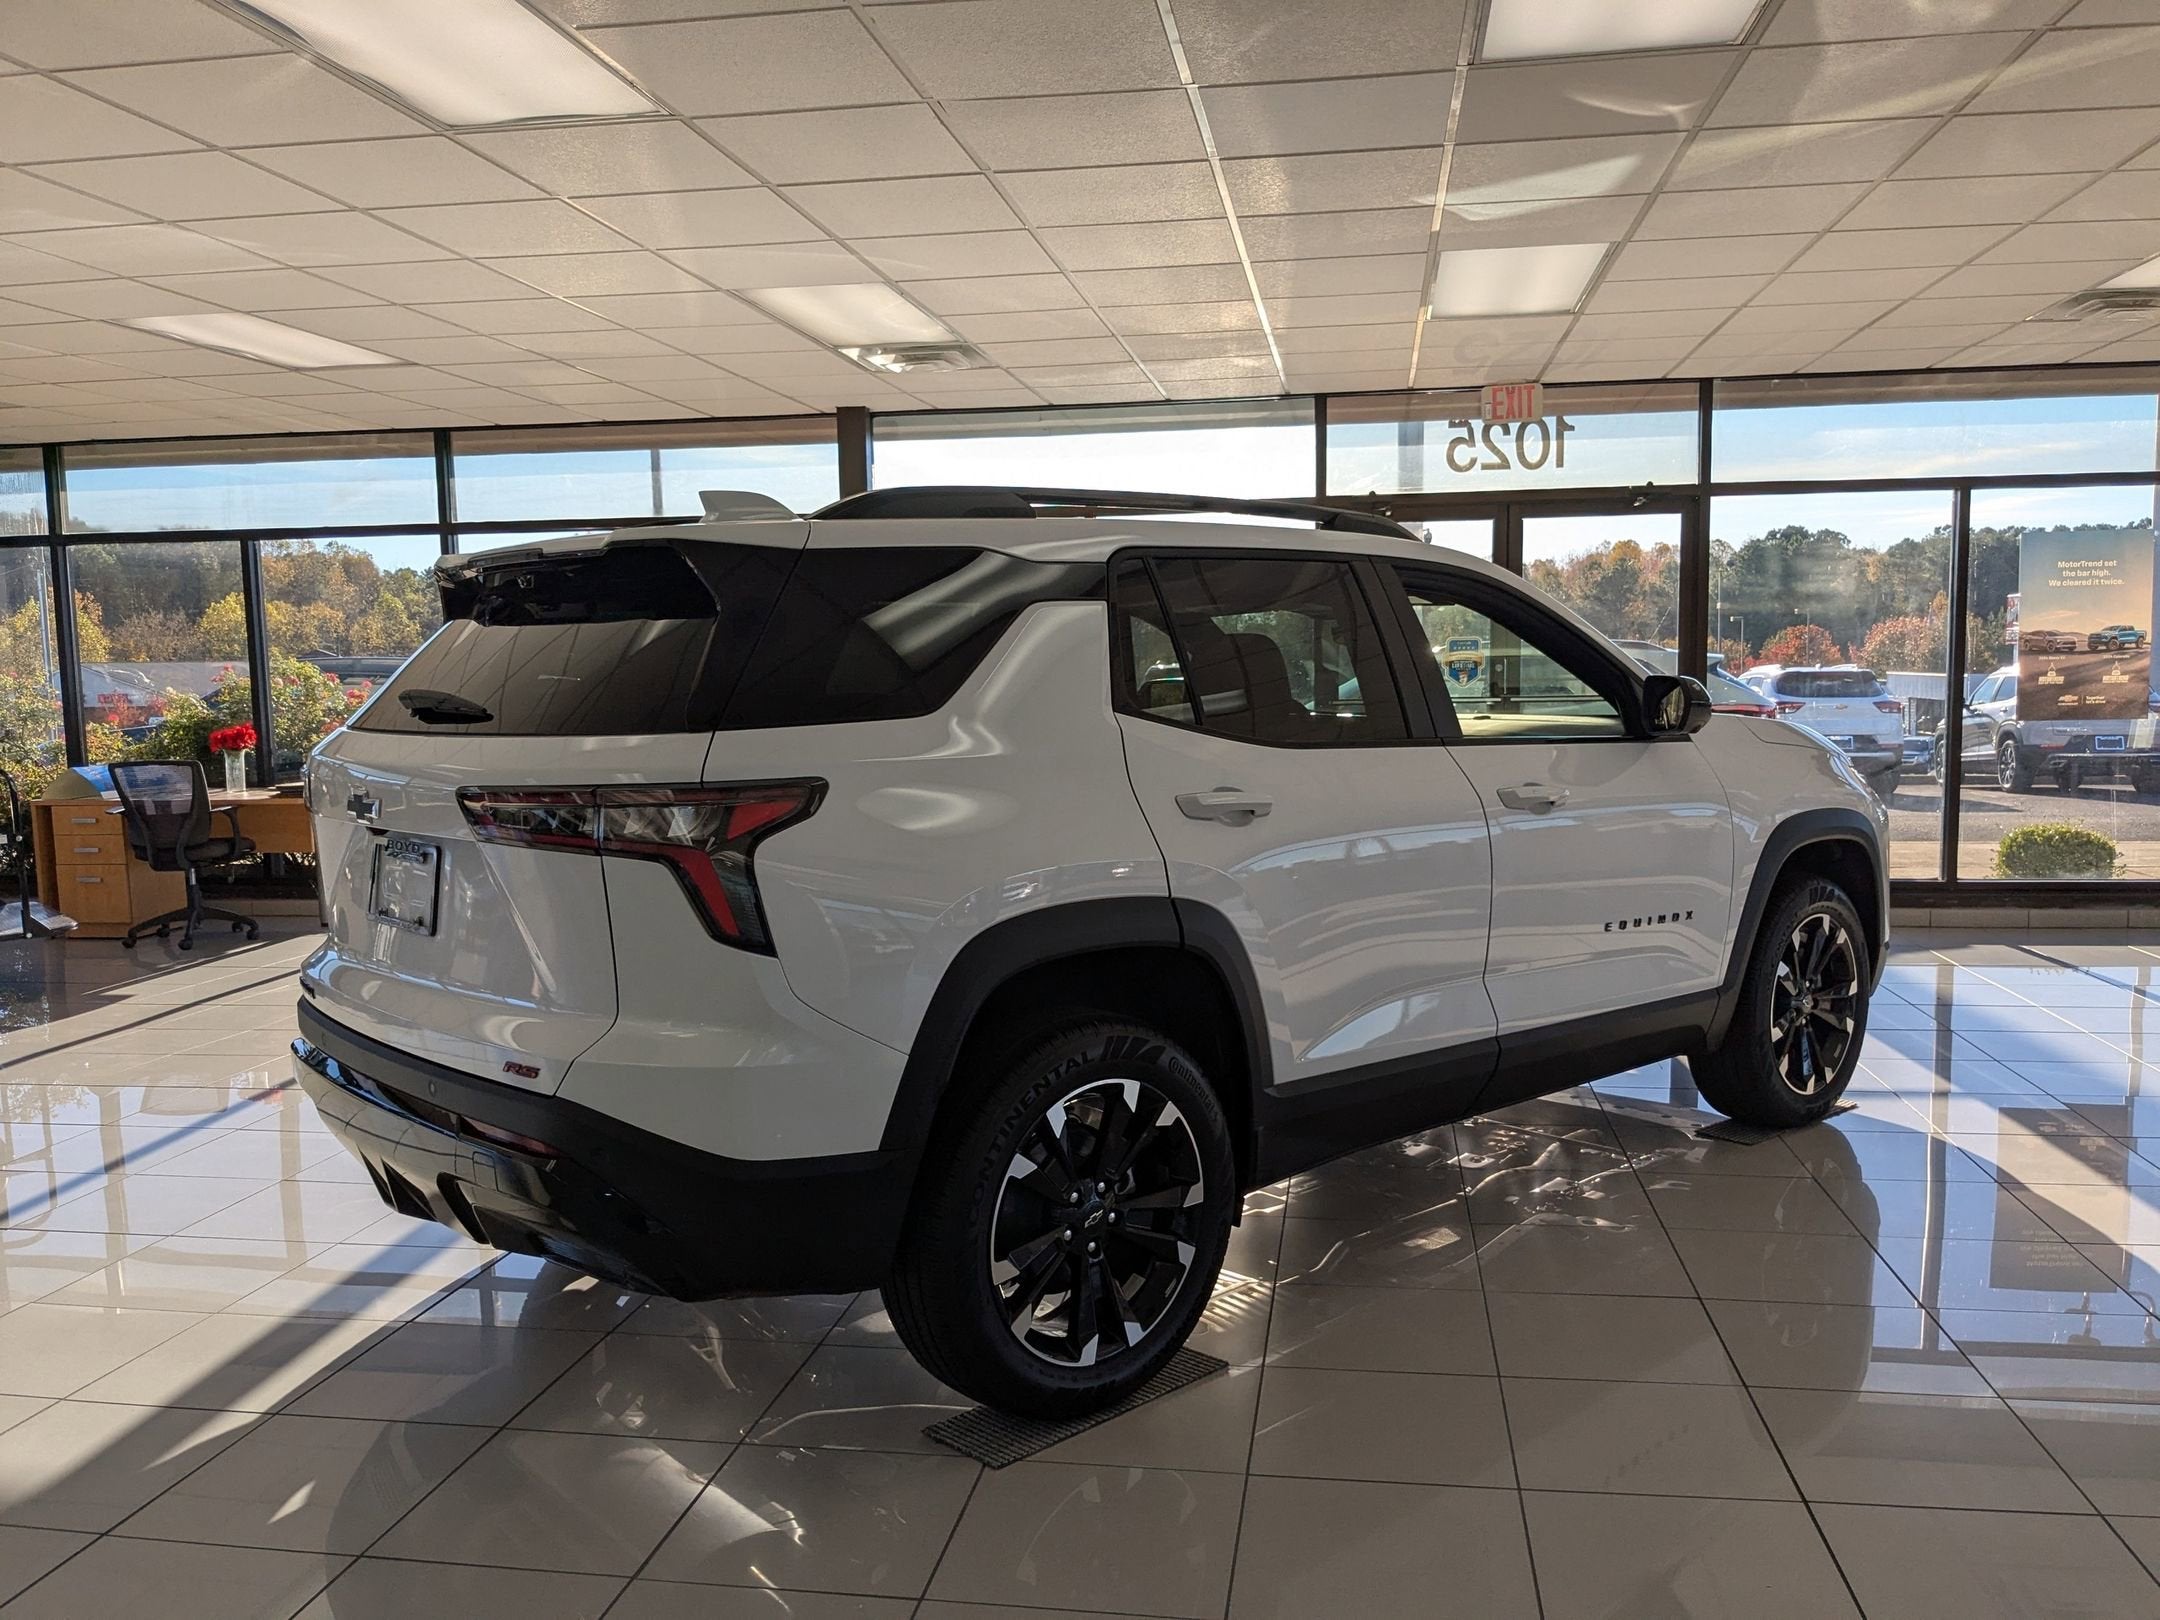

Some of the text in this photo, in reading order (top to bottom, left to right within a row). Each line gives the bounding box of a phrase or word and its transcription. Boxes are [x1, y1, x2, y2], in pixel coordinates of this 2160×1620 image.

[1491, 385, 1536, 420] EXIT
[2057, 560, 2103, 568] MotorTrend
[2077, 569, 2091, 577] bar
[2091, 569, 2111, 578] high.
[2048, 579, 2061, 587] We
[2062, 578, 2092, 587] cleared
[2100, 577, 2125, 585] twice.
[387, 838, 421, 854] BOYD
[1603, 910, 1694, 932] EQUINOX
[502, 1060, 541, 1079] RS
